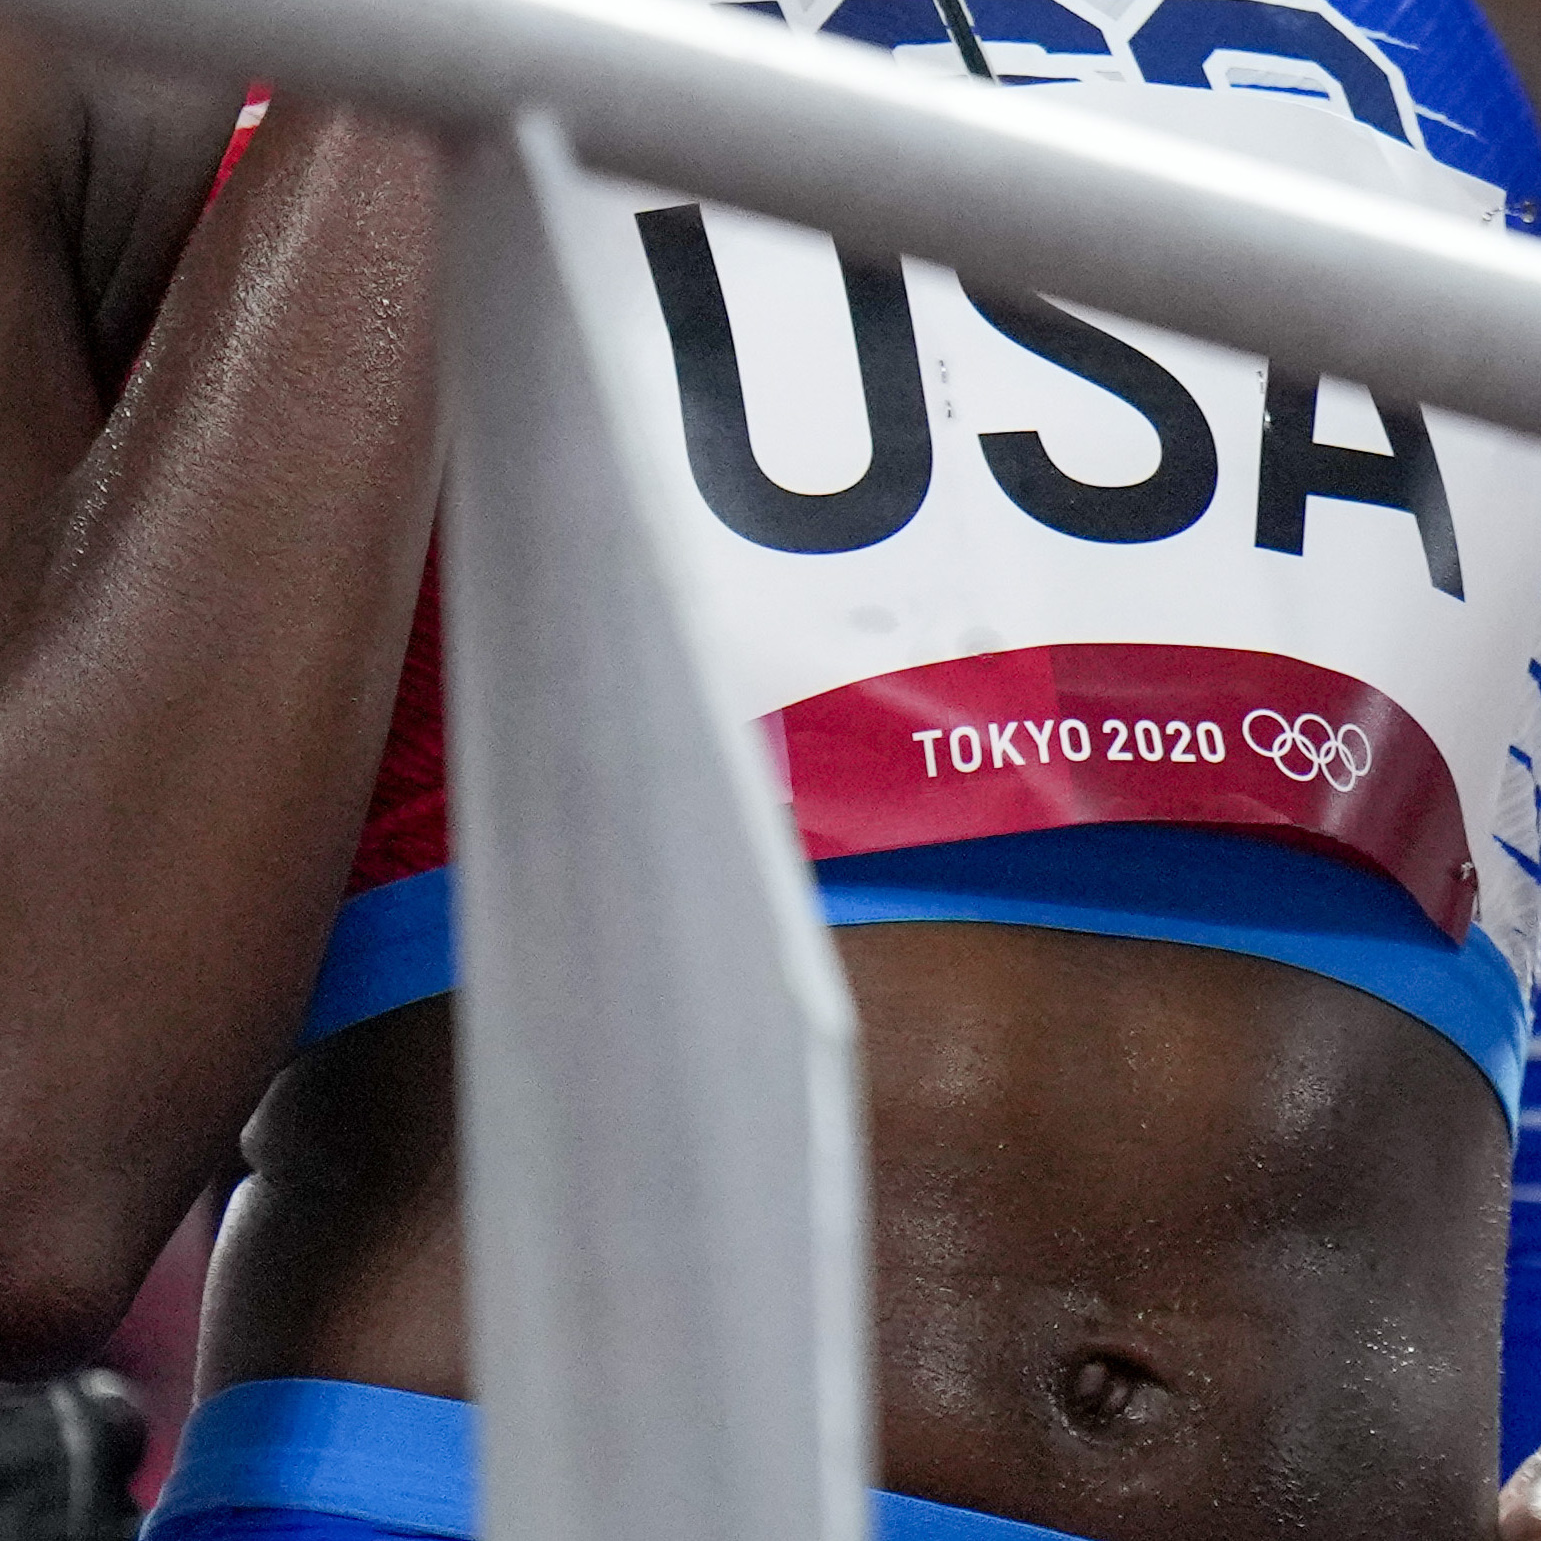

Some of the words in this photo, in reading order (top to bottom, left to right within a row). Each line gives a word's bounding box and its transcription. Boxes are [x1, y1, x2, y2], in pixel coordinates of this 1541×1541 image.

[633, 201, 1467, 603] USA
[911, 718, 1092, 778] TOKYO
[1102, 719, 1226, 764] 2020
